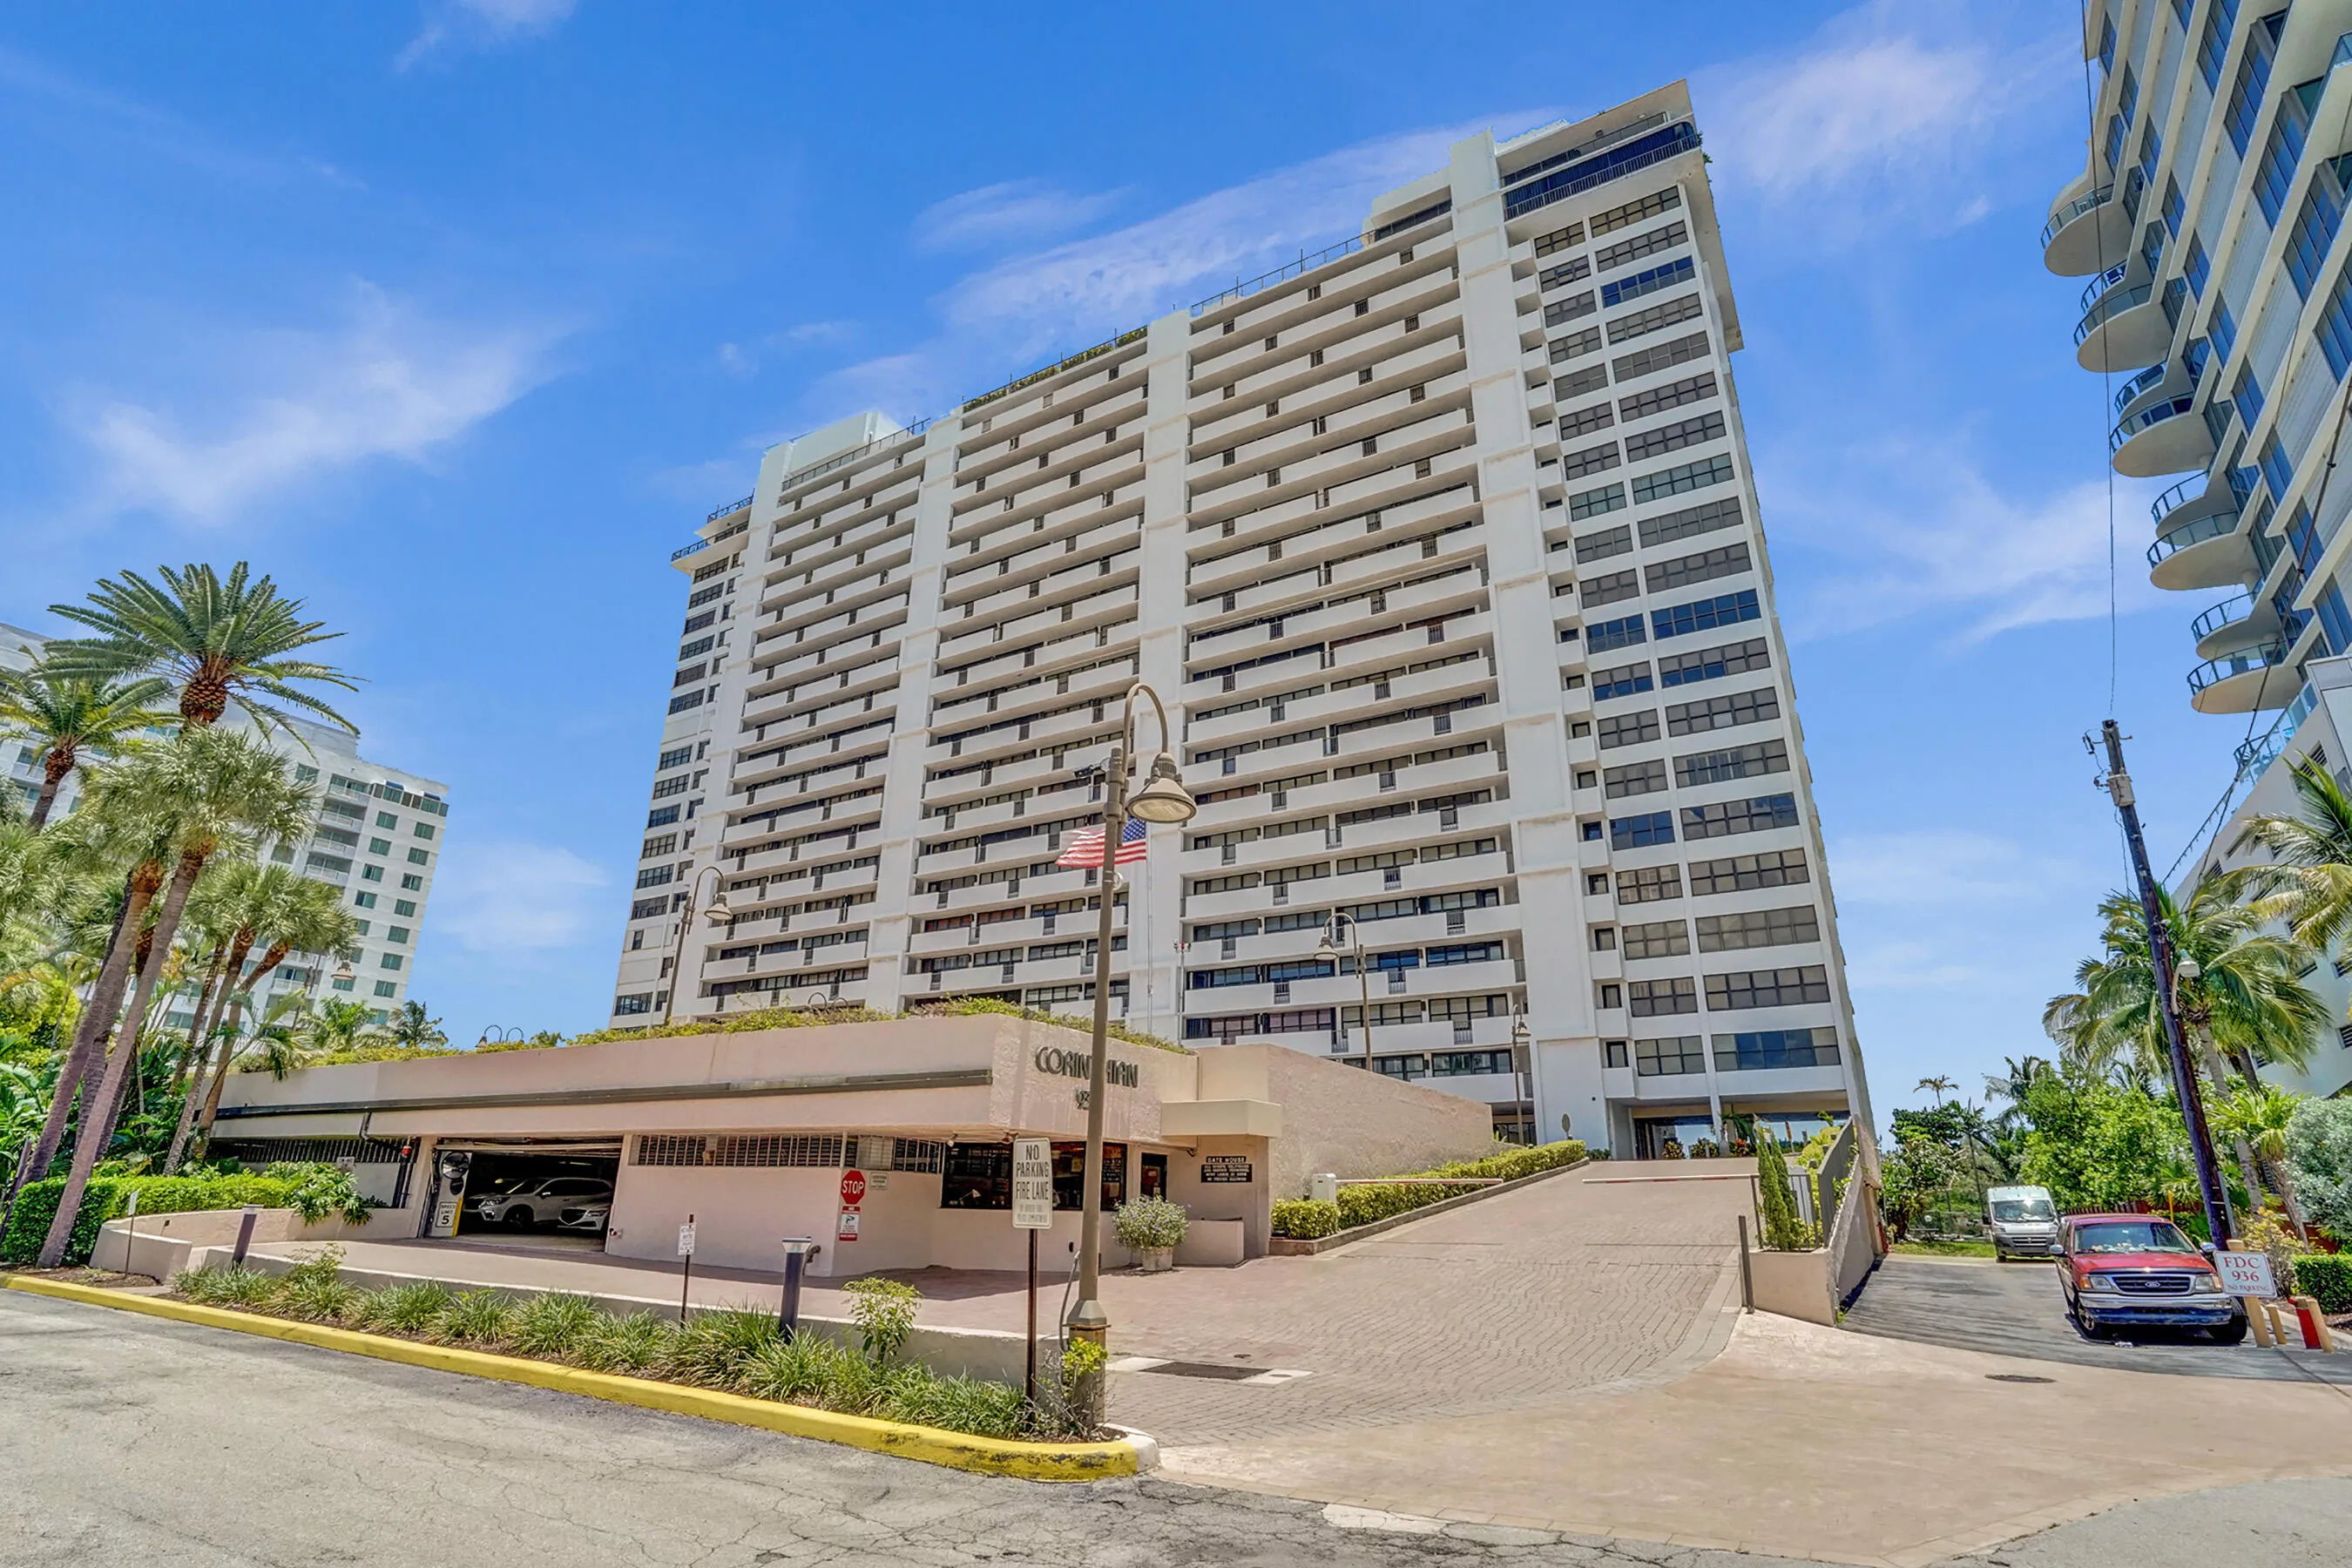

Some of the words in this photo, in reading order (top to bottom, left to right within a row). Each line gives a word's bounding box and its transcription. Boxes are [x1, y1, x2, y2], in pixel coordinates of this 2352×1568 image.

[1035, 1046, 1139, 1088] CORINHIAN
[1025, 1144, 1040, 1160] NO
[1016, 1161, 1050, 1178] PARKING
[841, 1180, 864, 1195] STOP
[1016, 1181, 1030, 1200] FIRE
[1032, 1181, 1049, 1200] LANE
[442, 1215, 449, 1225] 5
[2223, 1256, 2260, 1268] FDC
[2231, 1270, 2260, 1282] 936
